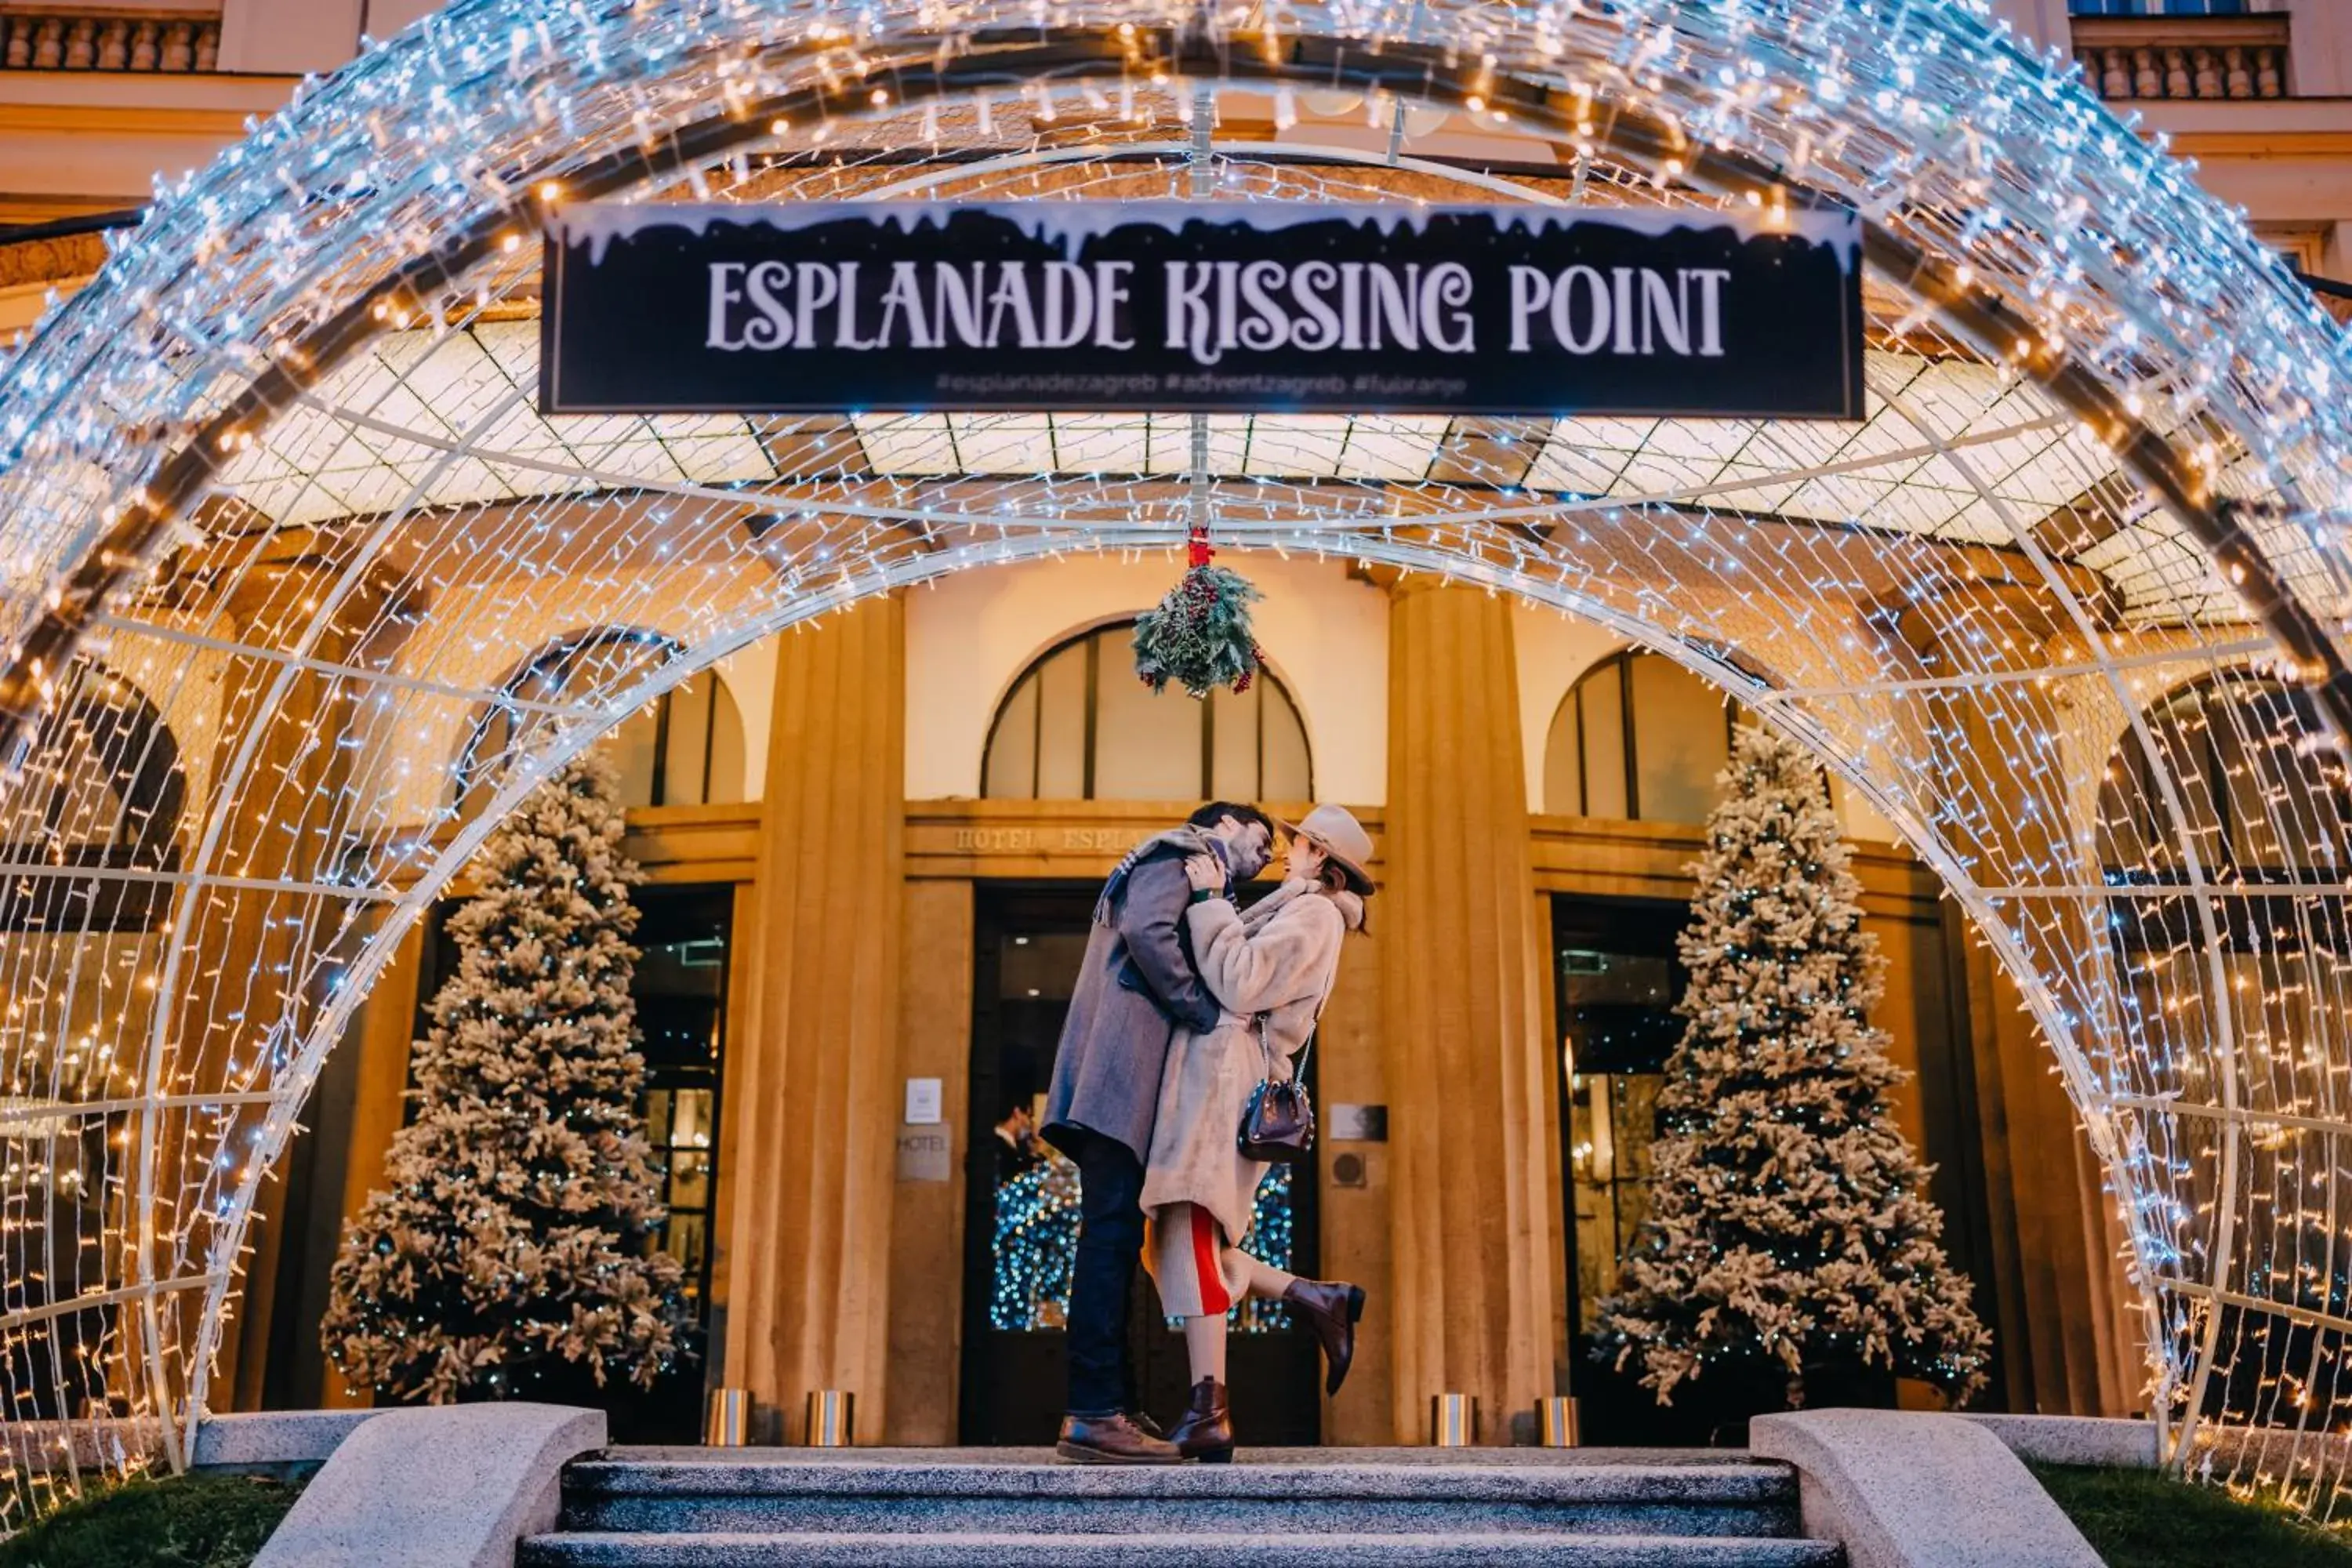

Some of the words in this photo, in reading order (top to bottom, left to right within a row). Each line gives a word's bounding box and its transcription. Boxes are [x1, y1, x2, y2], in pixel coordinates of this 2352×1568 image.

[706, 260, 1136, 351] ESPLANADE
[1163, 260, 1476, 365] KISSING
[1508, 265, 1731, 356] POINT
[936, 372, 1158, 396] #esplanadezagreb
[1166, 373, 1347, 397] #adventzagreb
[956, 829, 1037, 850] HOTEL
[897, 1135, 946, 1152] HOTEL
